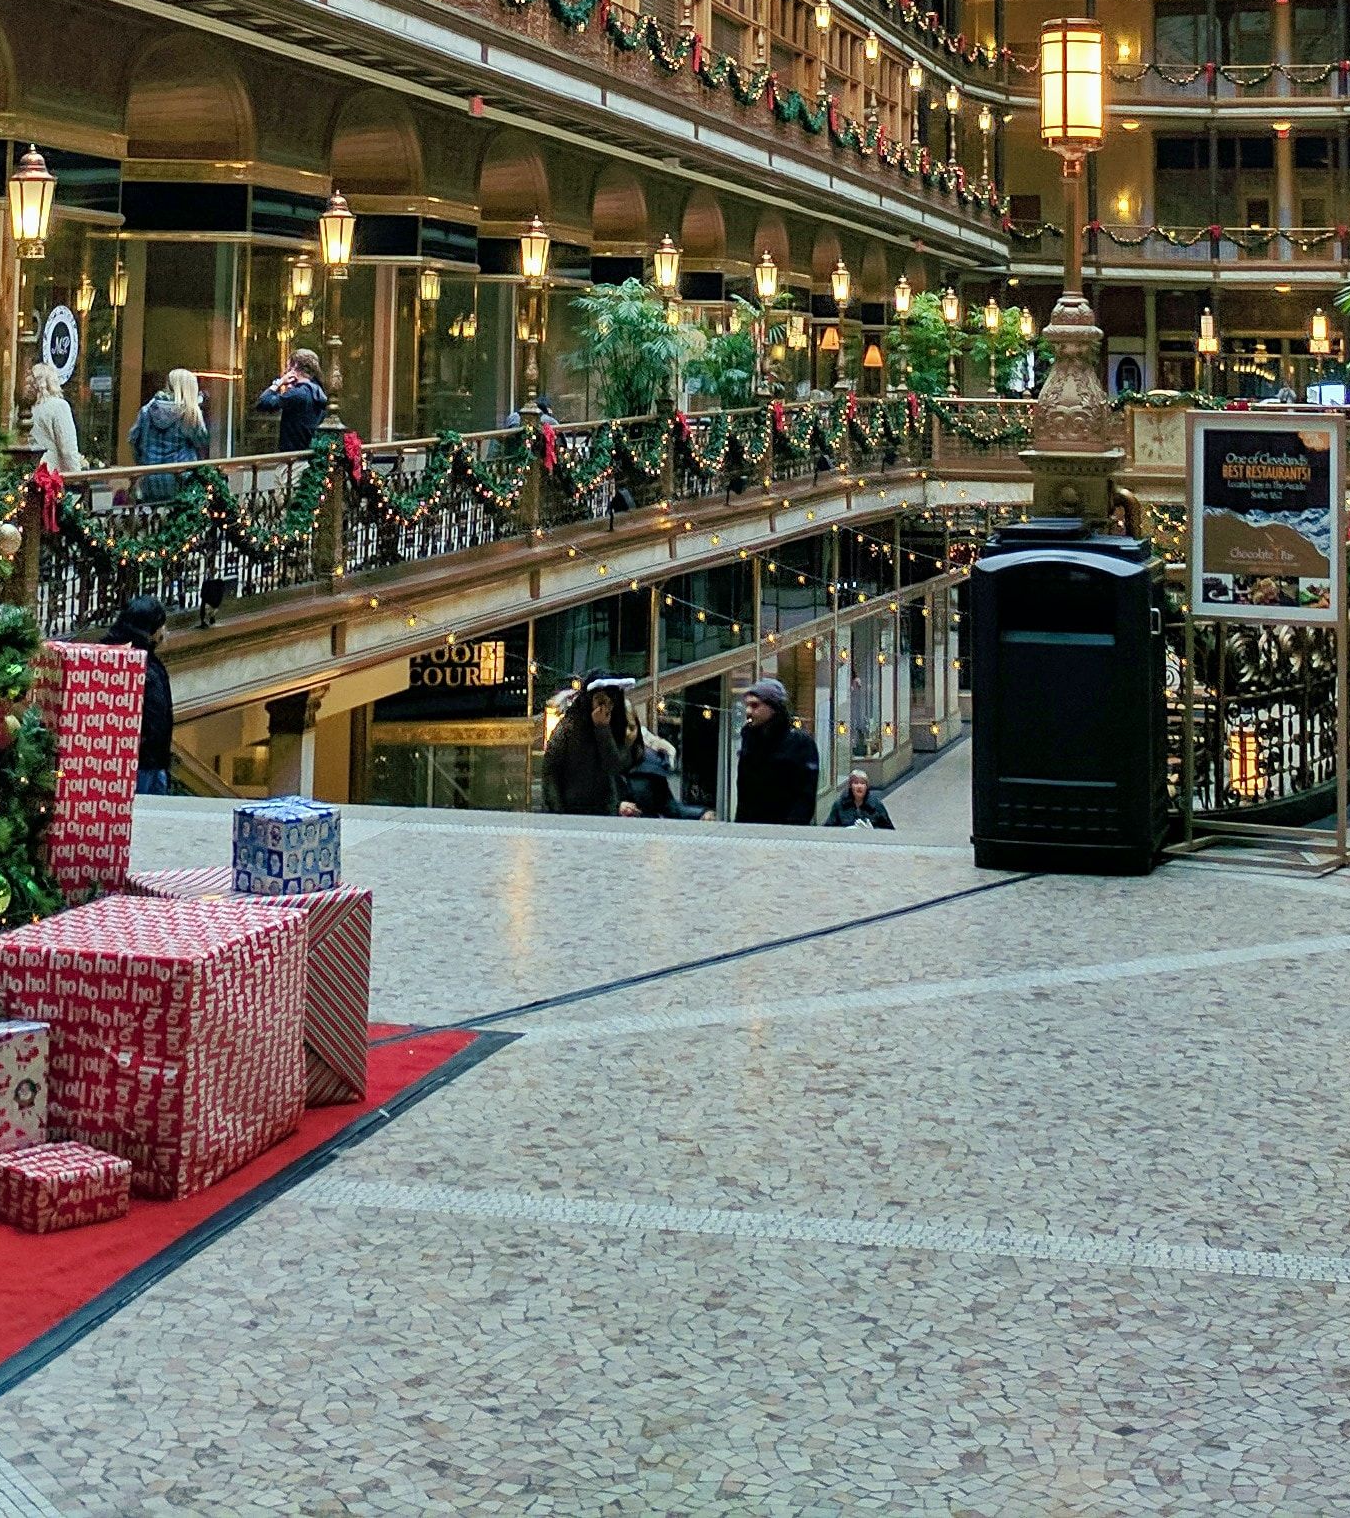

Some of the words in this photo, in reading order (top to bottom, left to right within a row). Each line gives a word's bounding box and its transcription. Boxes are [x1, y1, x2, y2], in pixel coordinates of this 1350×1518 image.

[1226, 452, 1246, 463] One
[1248, 451, 1259, 464] of
[1223, 464, 1245, 479] BEST
[1246, 464, 1311, 481] RESTAURANTS!
